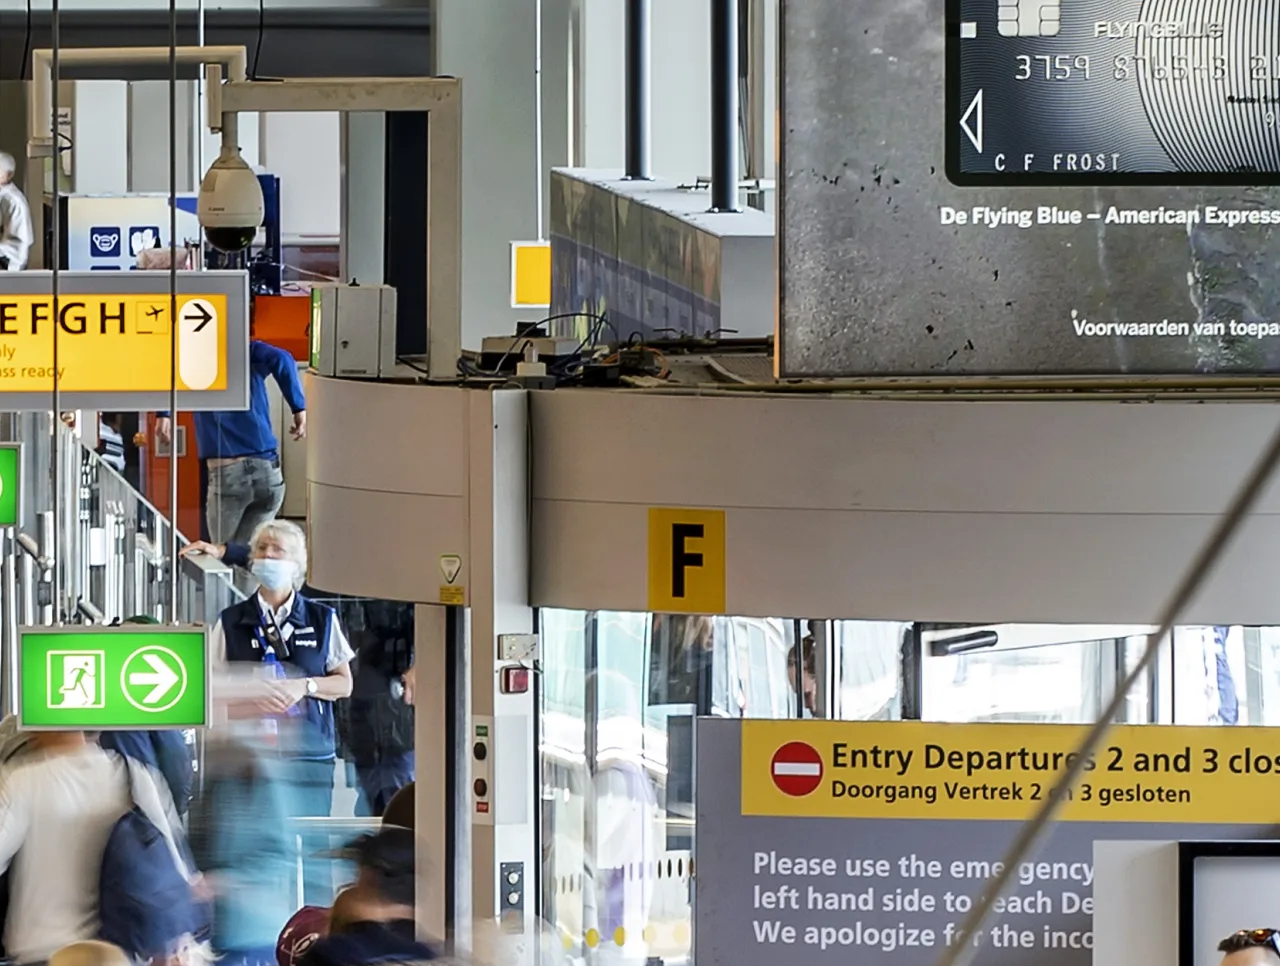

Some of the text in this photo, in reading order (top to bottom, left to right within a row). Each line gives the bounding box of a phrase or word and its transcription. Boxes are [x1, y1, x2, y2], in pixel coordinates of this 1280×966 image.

[1014, 54, 1091, 81] 3759
[1111, 54, 1228, 81] 876543
[994, 153, 1120, 171] C F FROST
[940, 206, 968, 225] De
[972, 206, 1033, 228] Flying
[1037, 206, 1083, 225] Blue
[1105, 206, 1200, 225] American
[1073, 319, 1189, 337] Voorwaarden
[1193, 321, 1225, 337] van
[21, 365, 66, 381] ready
[671, 523, 705, 598] F
[832, 743, 914, 775] Entry
[1106, 746, 1124, 772] 2
[1133, 746, 1192, 774] and
[1202, 748, 1219, 774] 3
[831, 780, 938, 803] Doorgang
[944, 781, 1024, 801] Vertrek
[1029, 783, 1043, 800] 2
[1080, 783, 1093, 801] 3
[1098, 783, 1192, 806] gesloten
[753, 851, 1094, 886] Please use the emegency
[753, 885, 800, 910] left
[807, 887, 874, 912] hand
[881, 888, 936, 913] side
[943, 890, 972, 914] to
[982, 892, 1052, 916] each
[752, 920, 797, 945] We
[803, 922, 936, 951] apologize
[990, 924, 1036, 950] the
